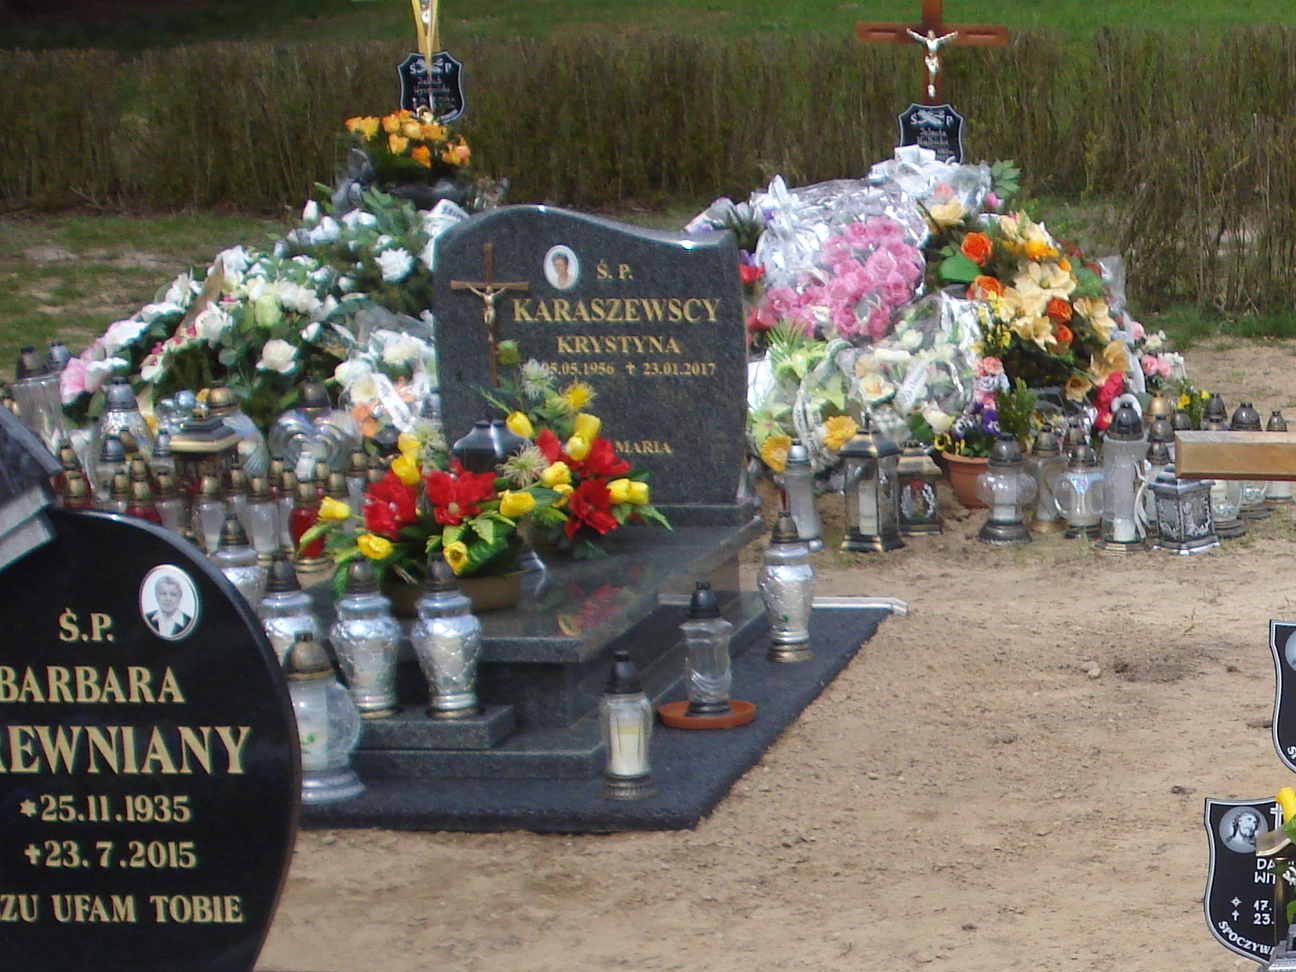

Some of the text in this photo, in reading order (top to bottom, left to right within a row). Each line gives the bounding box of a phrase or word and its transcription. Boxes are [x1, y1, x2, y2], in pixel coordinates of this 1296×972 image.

[513, 298, 720, 323] KARASZEWSCY
[556, 335, 680, 354] KRYSTYNA
[642, 361, 717, 376] 23.01.2017
[615, 440, 673, 454] MARIA
[0, 665, 186, 704] BARBARA
[0, 725, 251, 775] EWNIANY
[52, 894, 136, 923] UFAM
[150, 894, 244, 924] TOBIE
